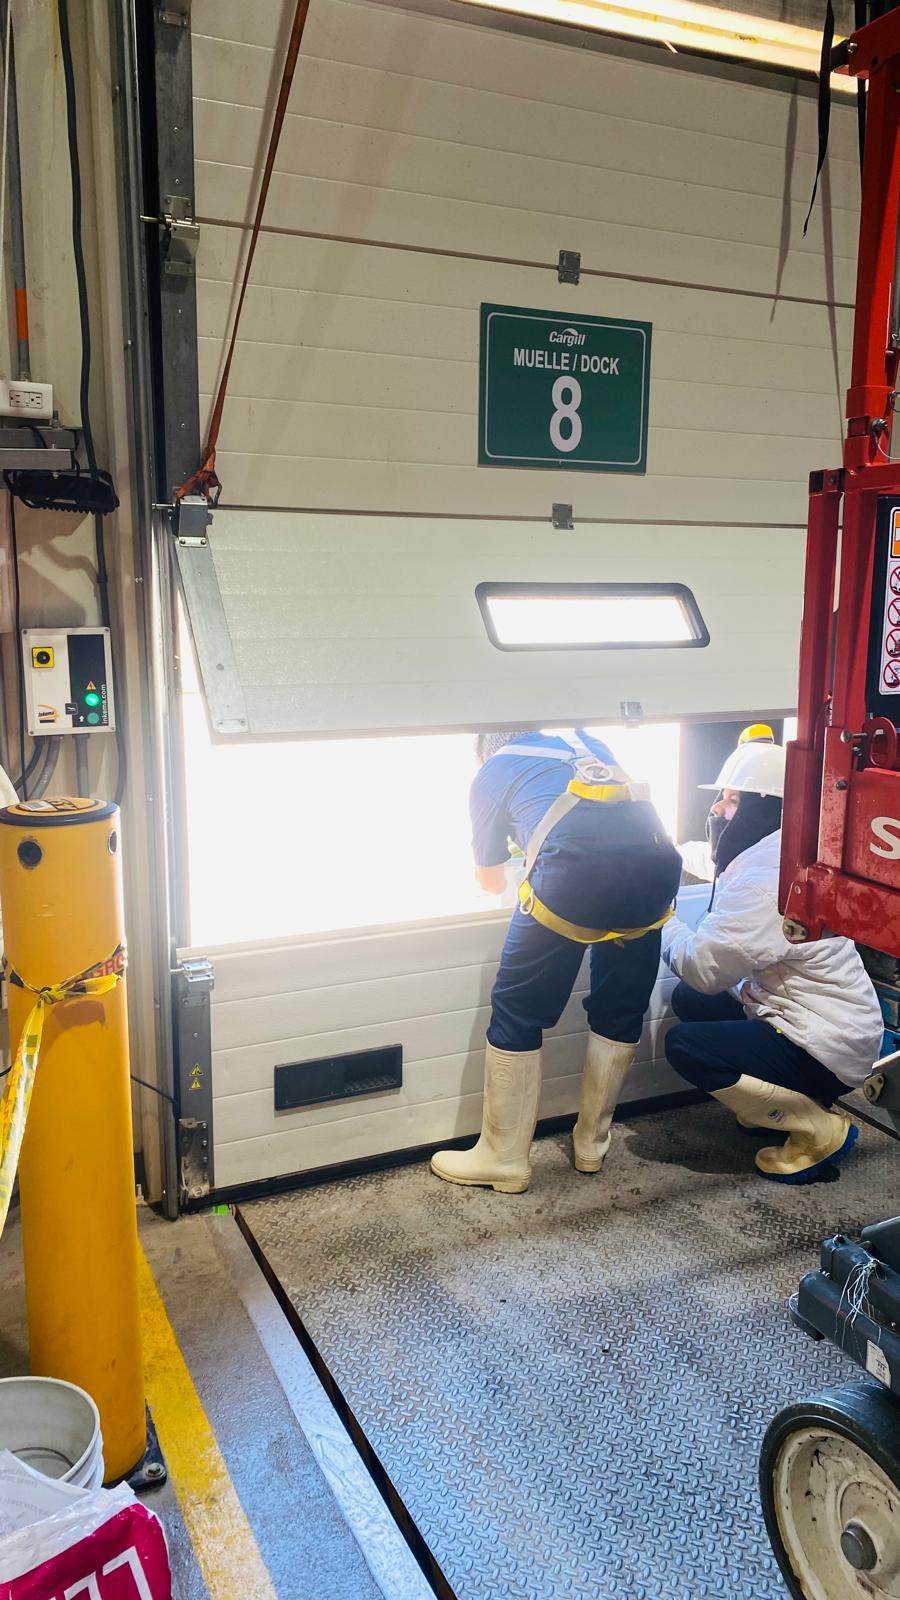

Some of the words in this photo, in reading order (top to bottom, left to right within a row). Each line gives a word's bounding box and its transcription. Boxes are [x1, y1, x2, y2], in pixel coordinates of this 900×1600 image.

[549, 328, 585, 347] Cargill
[514, 347, 569, 371] MUELLE
[573, 353, 577, 372] /
[581, 355, 619, 375] DOCK
[549, 375, 583, 453] 8
